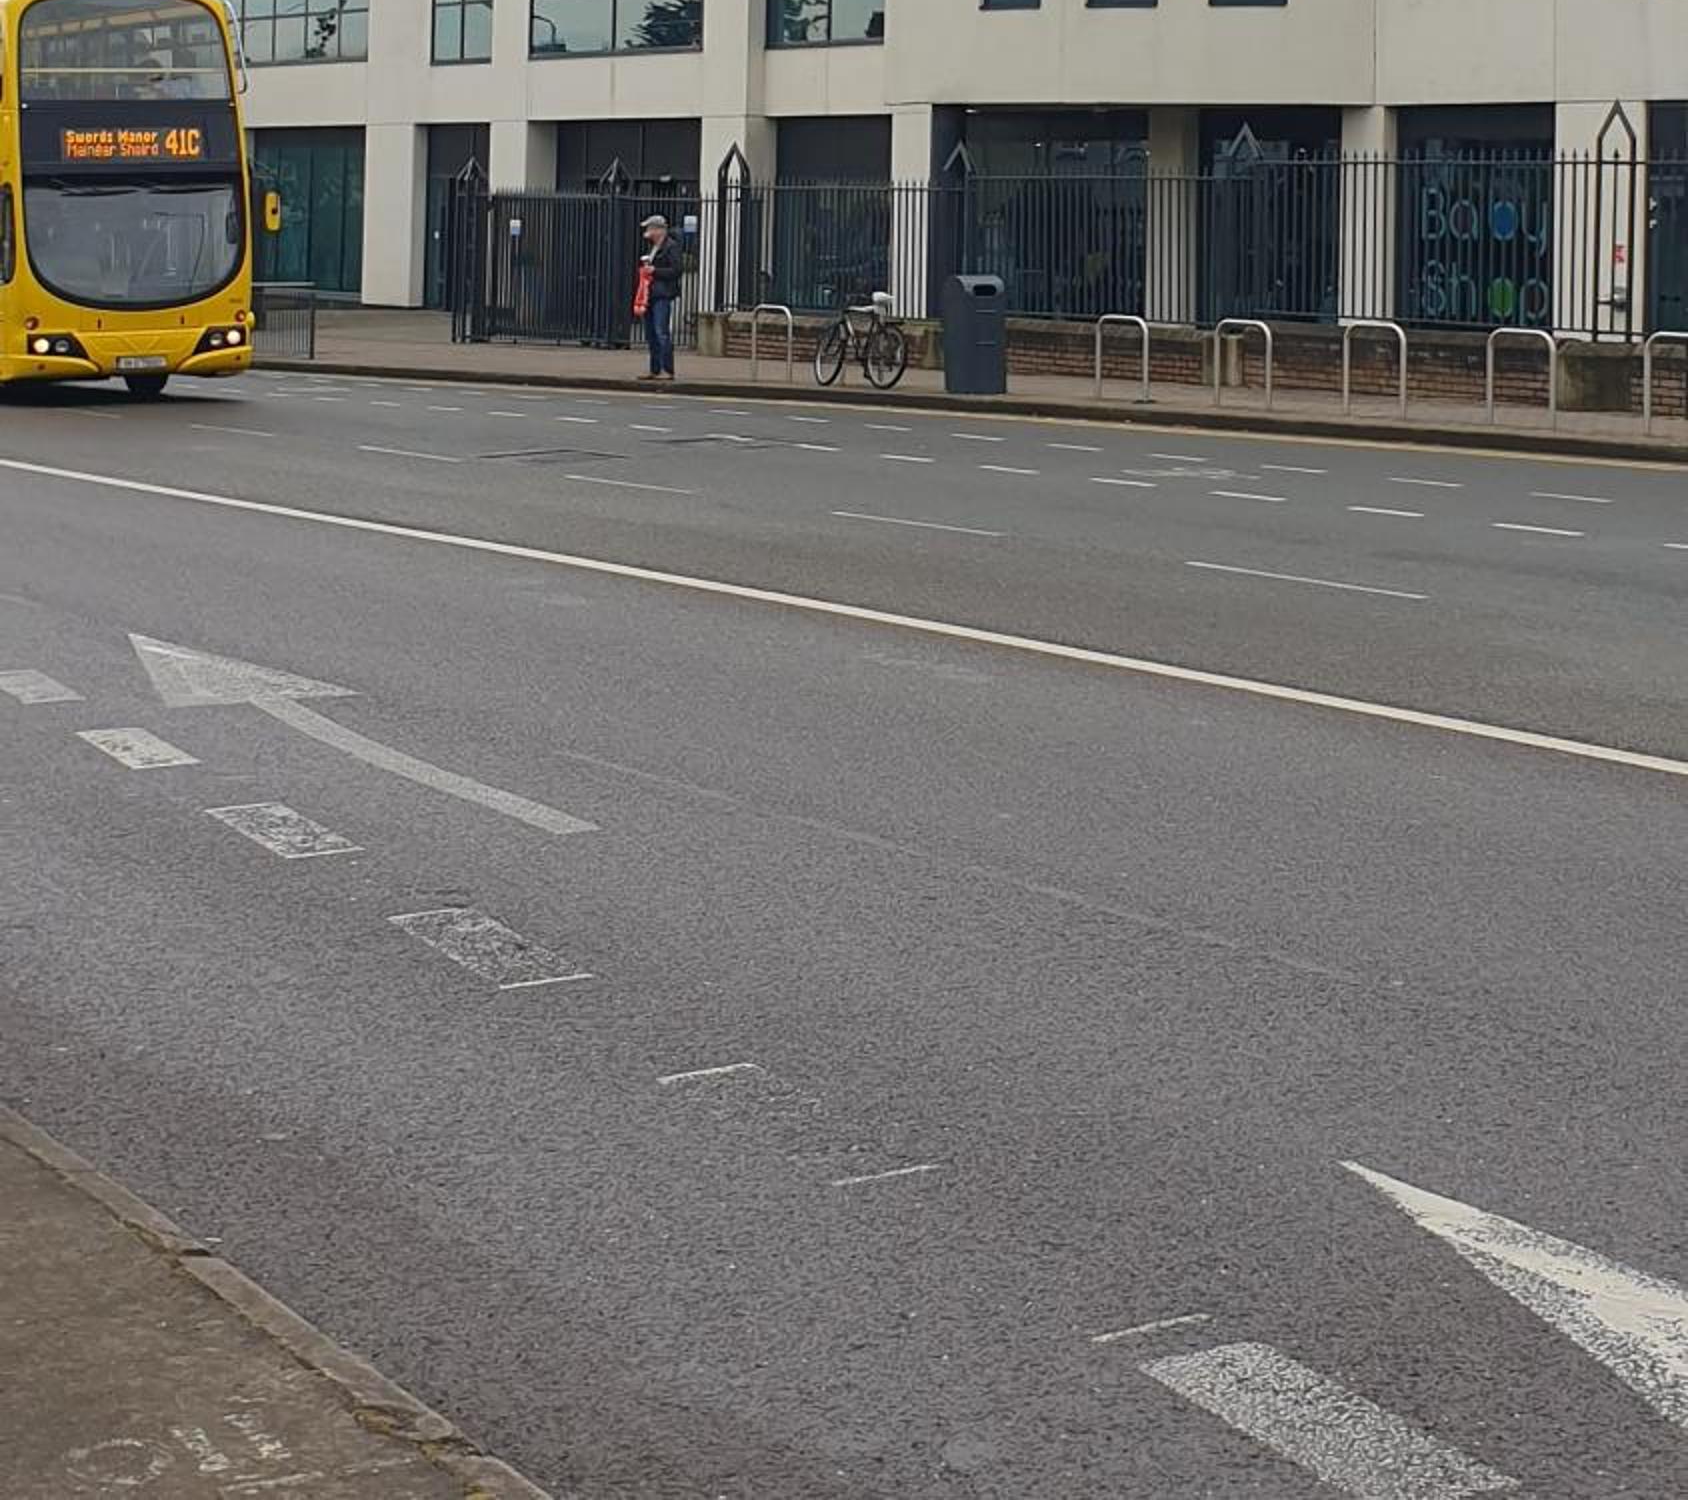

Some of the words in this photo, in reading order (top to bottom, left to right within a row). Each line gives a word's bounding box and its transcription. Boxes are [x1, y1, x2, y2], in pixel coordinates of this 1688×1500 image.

[66, 130, 113, 143] Swords
[118, 129, 158, 143] Manor
[165, 128, 201, 155] 41C
[1421, 186, 1548, 257] Baby
[1421, 260, 1550, 325] Shop
